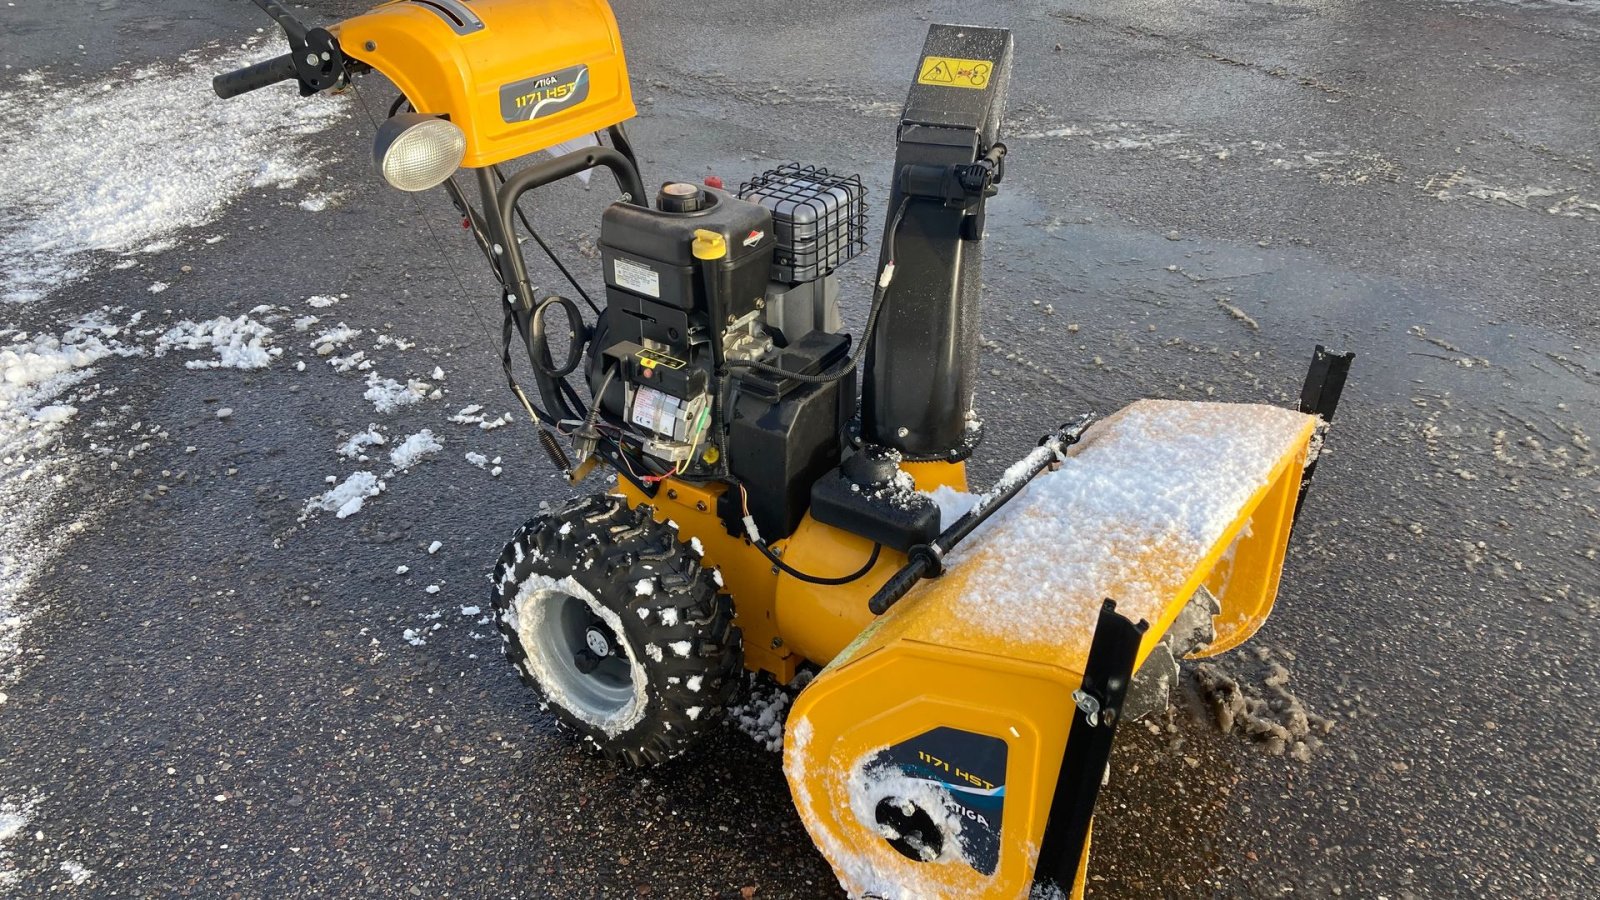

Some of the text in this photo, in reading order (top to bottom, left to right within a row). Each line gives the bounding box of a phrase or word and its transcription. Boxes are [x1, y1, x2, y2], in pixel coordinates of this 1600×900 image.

[515, 81, 576, 108] 1171 HST
[534, 76, 557, 89] STIGA
[918, 750, 994, 791] 1171 HST
[951, 802, 989, 828] TIGA
